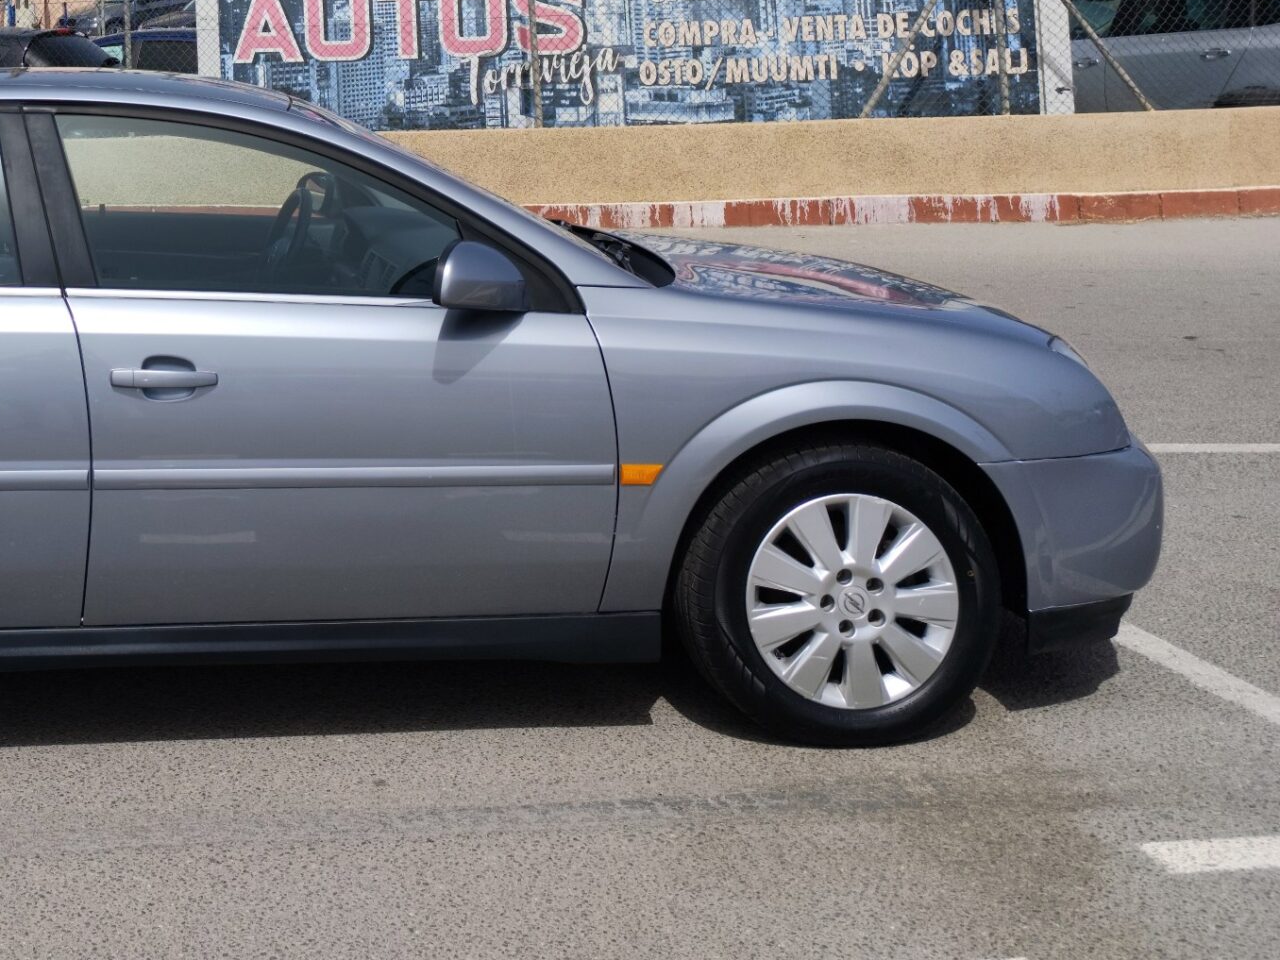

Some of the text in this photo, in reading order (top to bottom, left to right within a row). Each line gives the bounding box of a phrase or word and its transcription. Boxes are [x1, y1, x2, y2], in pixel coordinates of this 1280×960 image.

[643, 18, 757, 47] COMPRA
[783, 14, 867, 41] VENTA
[877, 12, 912, 39] DE
